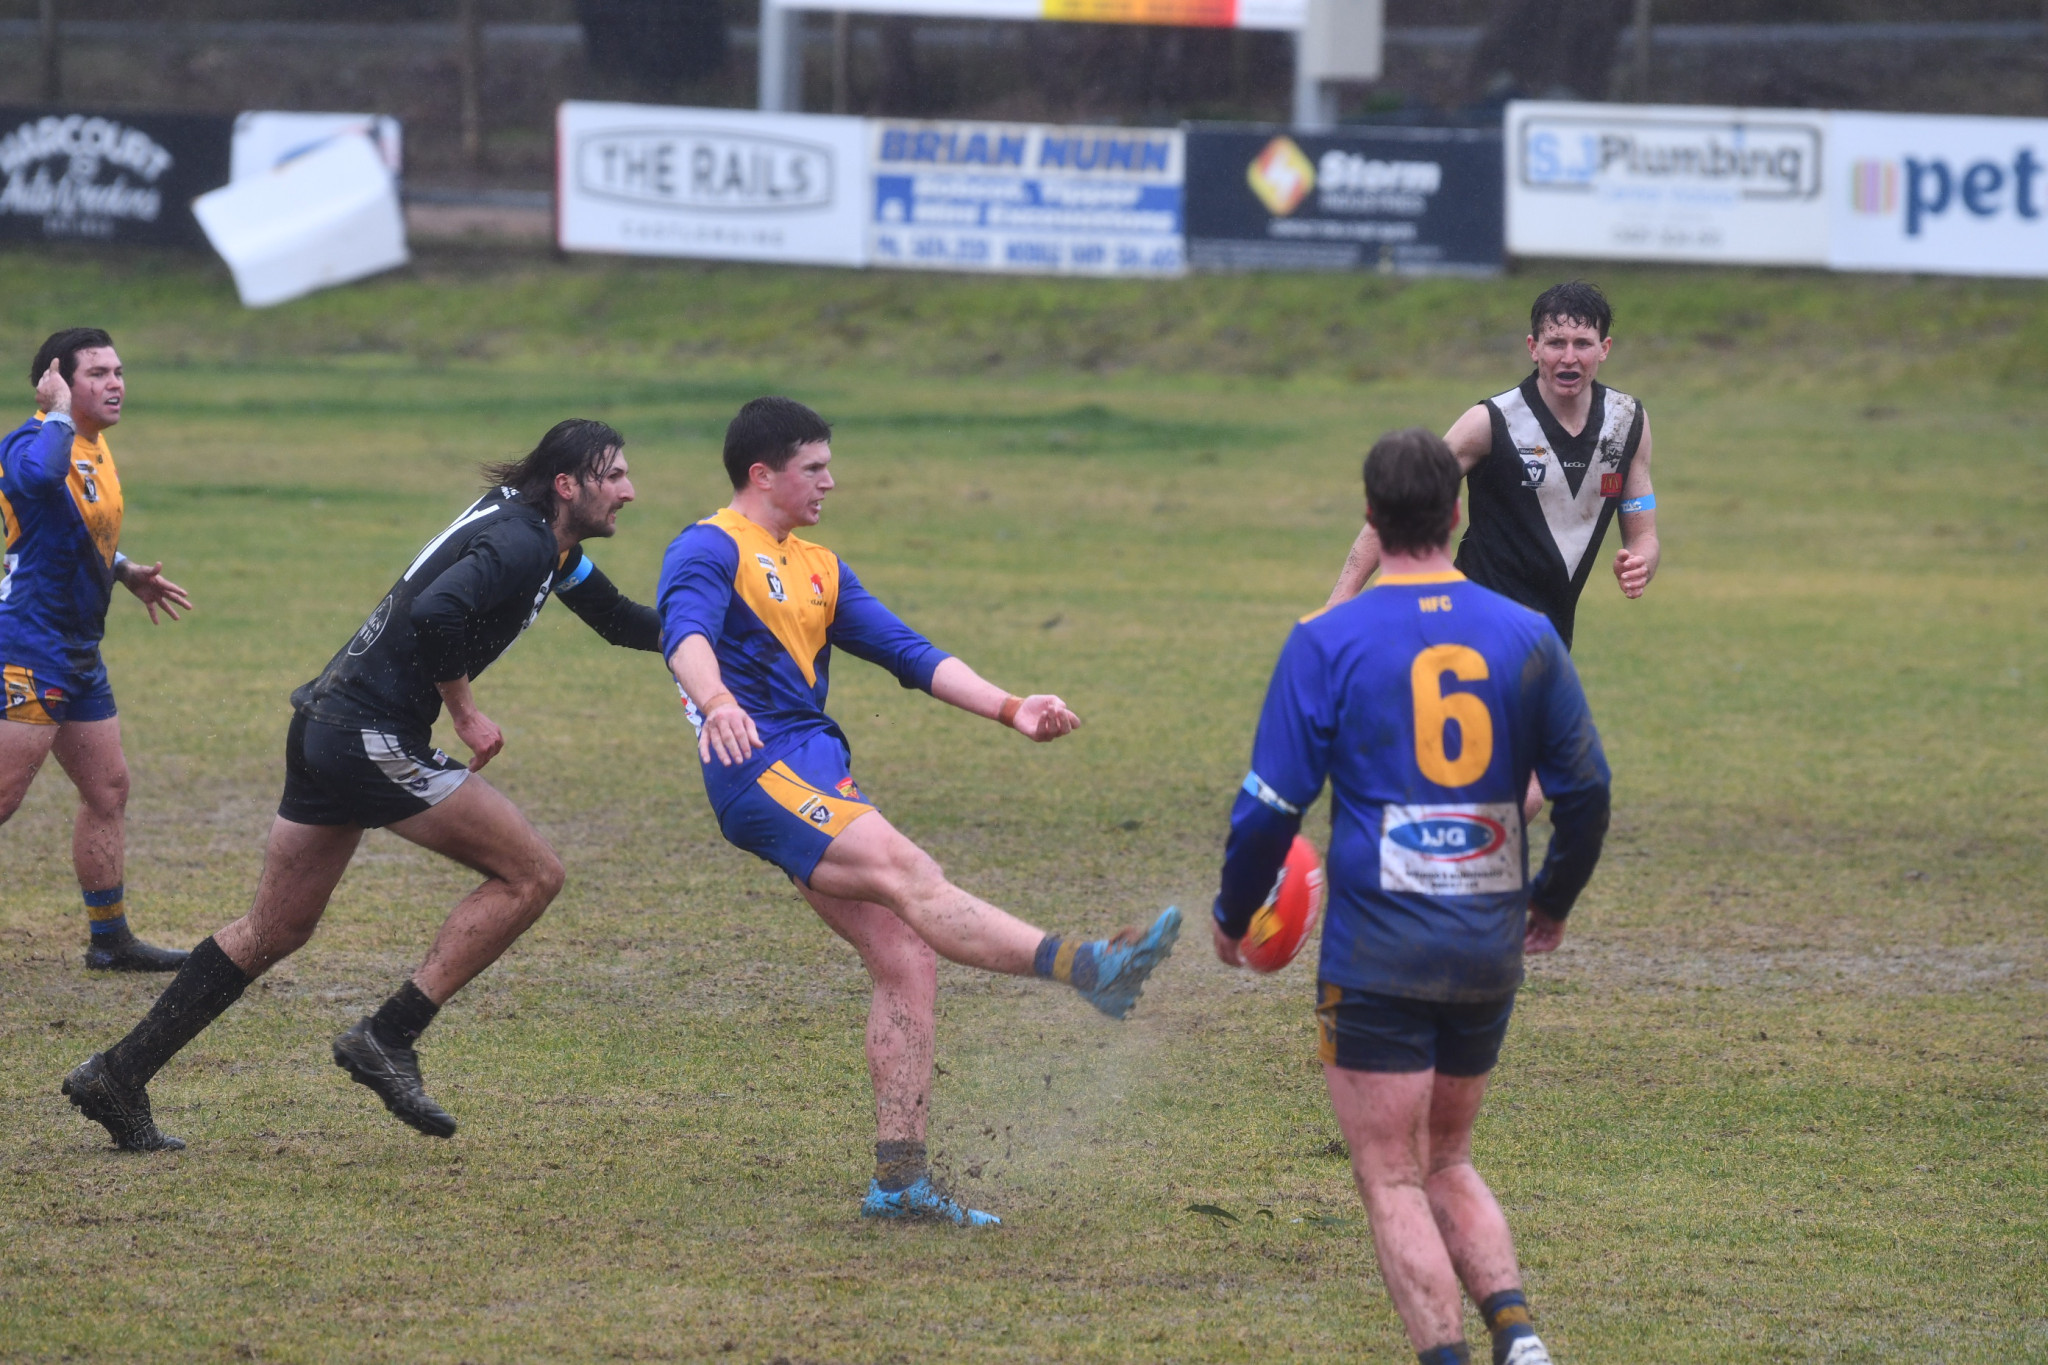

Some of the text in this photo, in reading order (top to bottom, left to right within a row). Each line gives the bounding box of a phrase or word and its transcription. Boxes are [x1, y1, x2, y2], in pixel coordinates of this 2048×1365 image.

[599, 143, 811, 199] THE RAILS
[881, 128, 1172, 172] BRIAN NUNN
[1319, 151, 1441, 193] Storm
[1599, 125, 1803, 195] Plumbing
[1904, 147, 2042, 236] pet
[1418, 595, 1453, 613] HFC
[1411, 643, 1493, 788] 6
